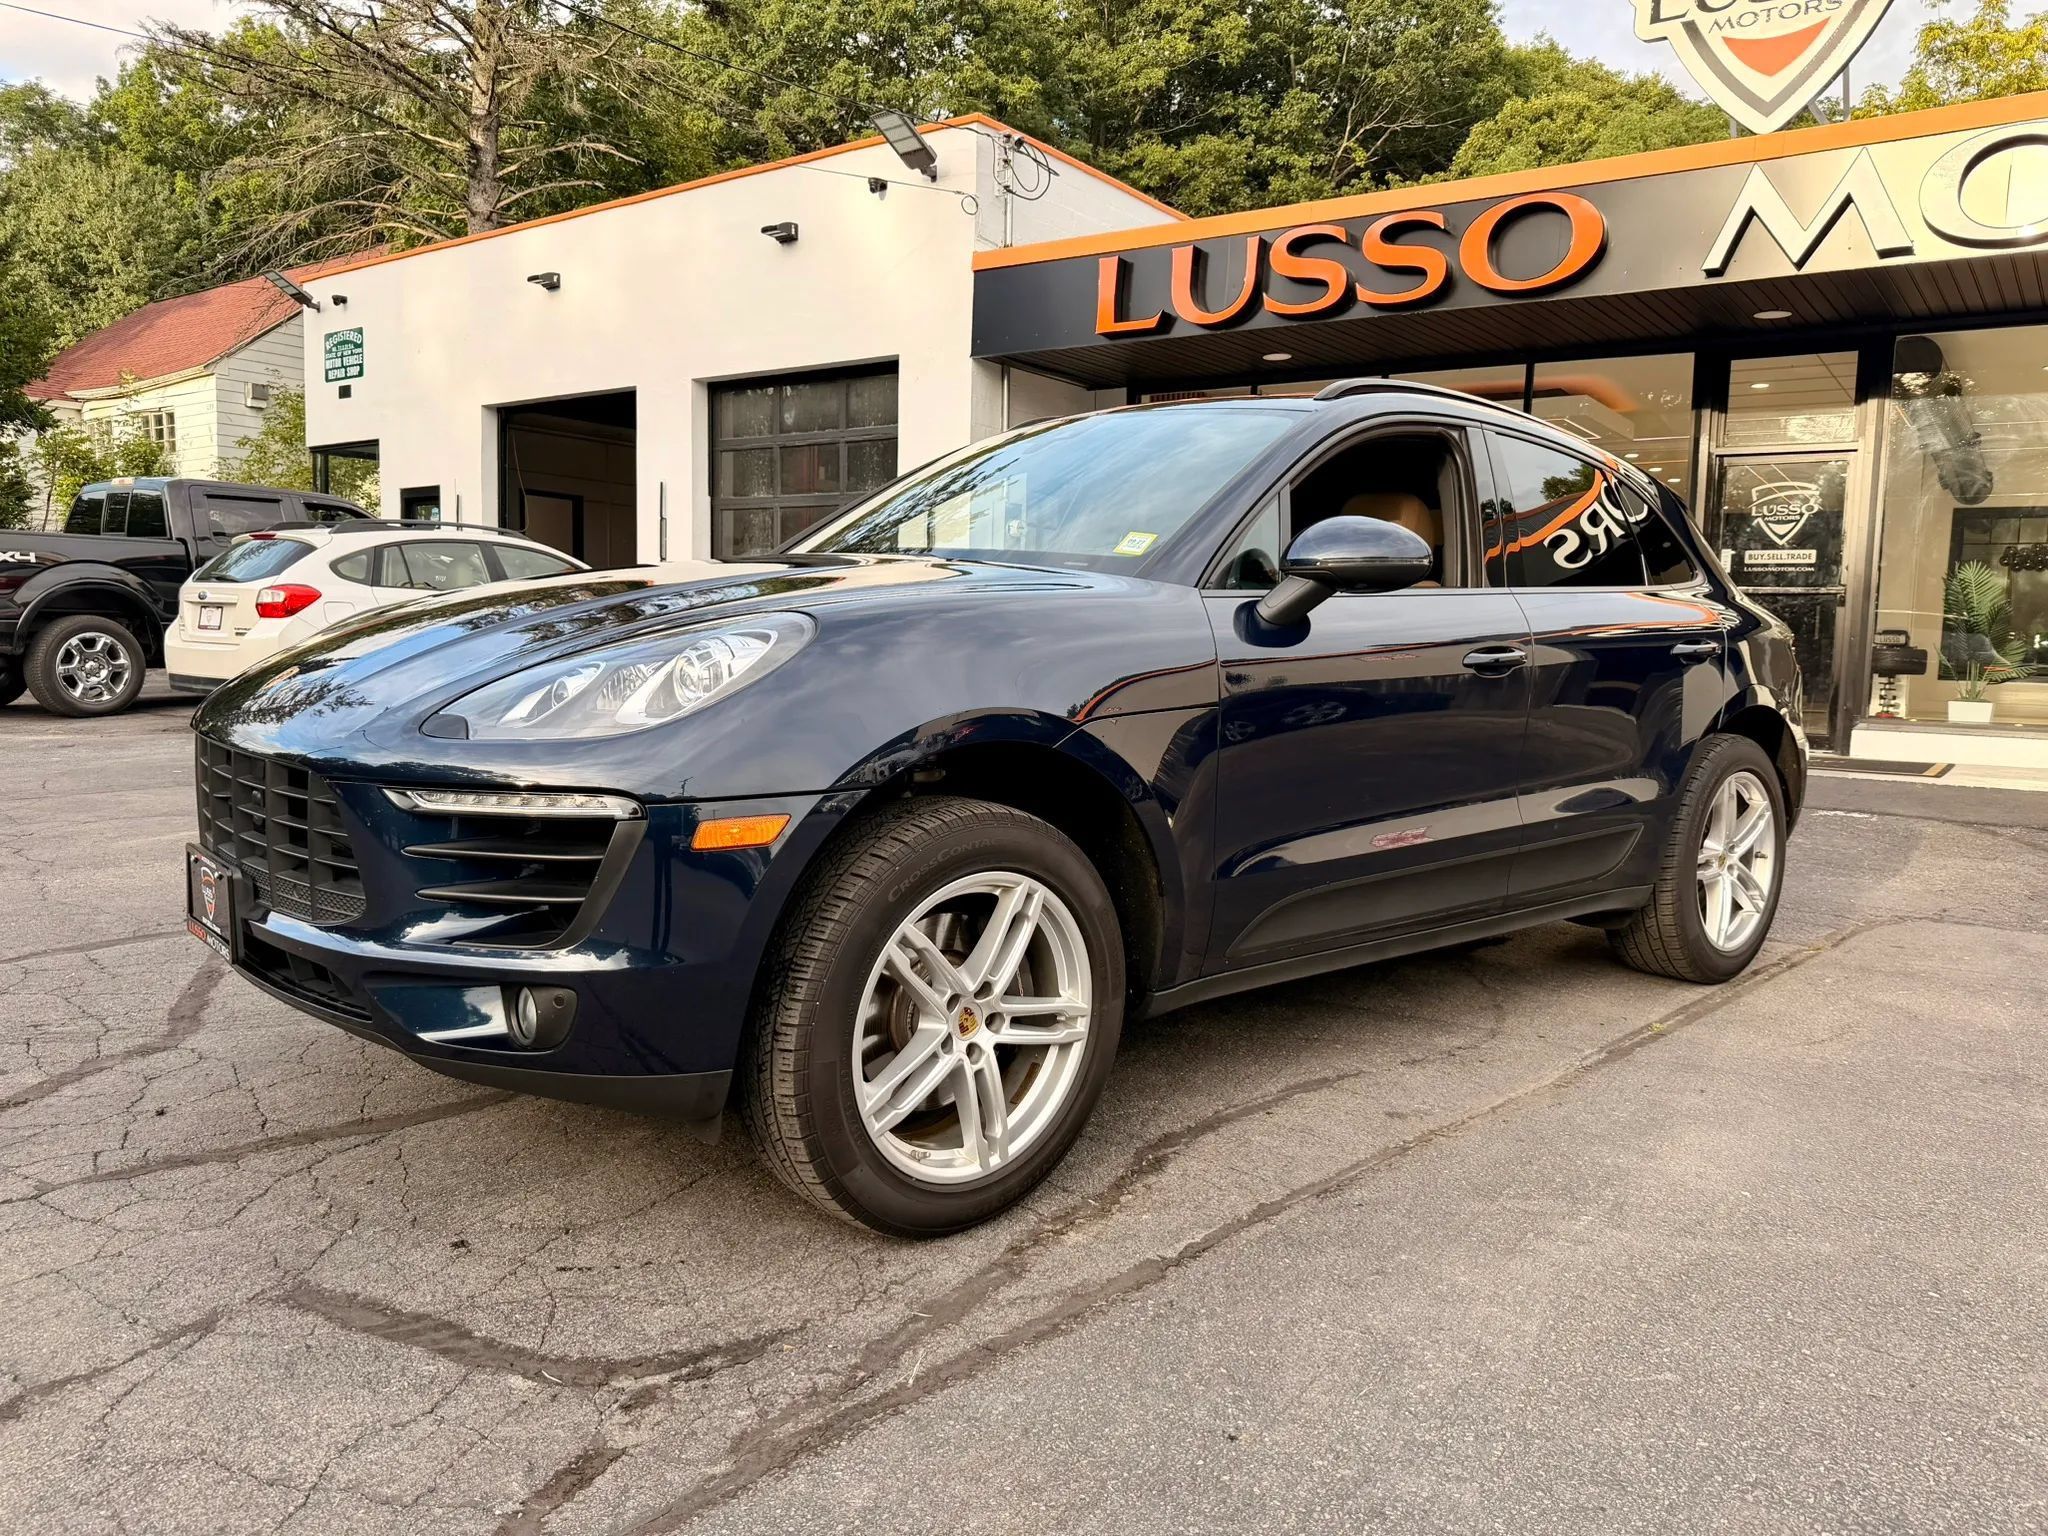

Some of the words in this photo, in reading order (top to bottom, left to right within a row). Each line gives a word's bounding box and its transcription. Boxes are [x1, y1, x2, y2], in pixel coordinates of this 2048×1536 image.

[1708, 0, 1842, 34] MOTORS
[1095, 191, 1607, 335] LUSSO
[326, 331, 362, 350] REGISTERED
[325, 357, 342, 369] MOTOR
[342, 354, 363, 366] VEHICLE
[328, 368, 345, 380] REPAIR
[346, 365, 360, 377] SHOP
[1751, 503, 1819, 517] LUSSO
[1747, 552, 1813, 561] BUY.SELL.TRADE
